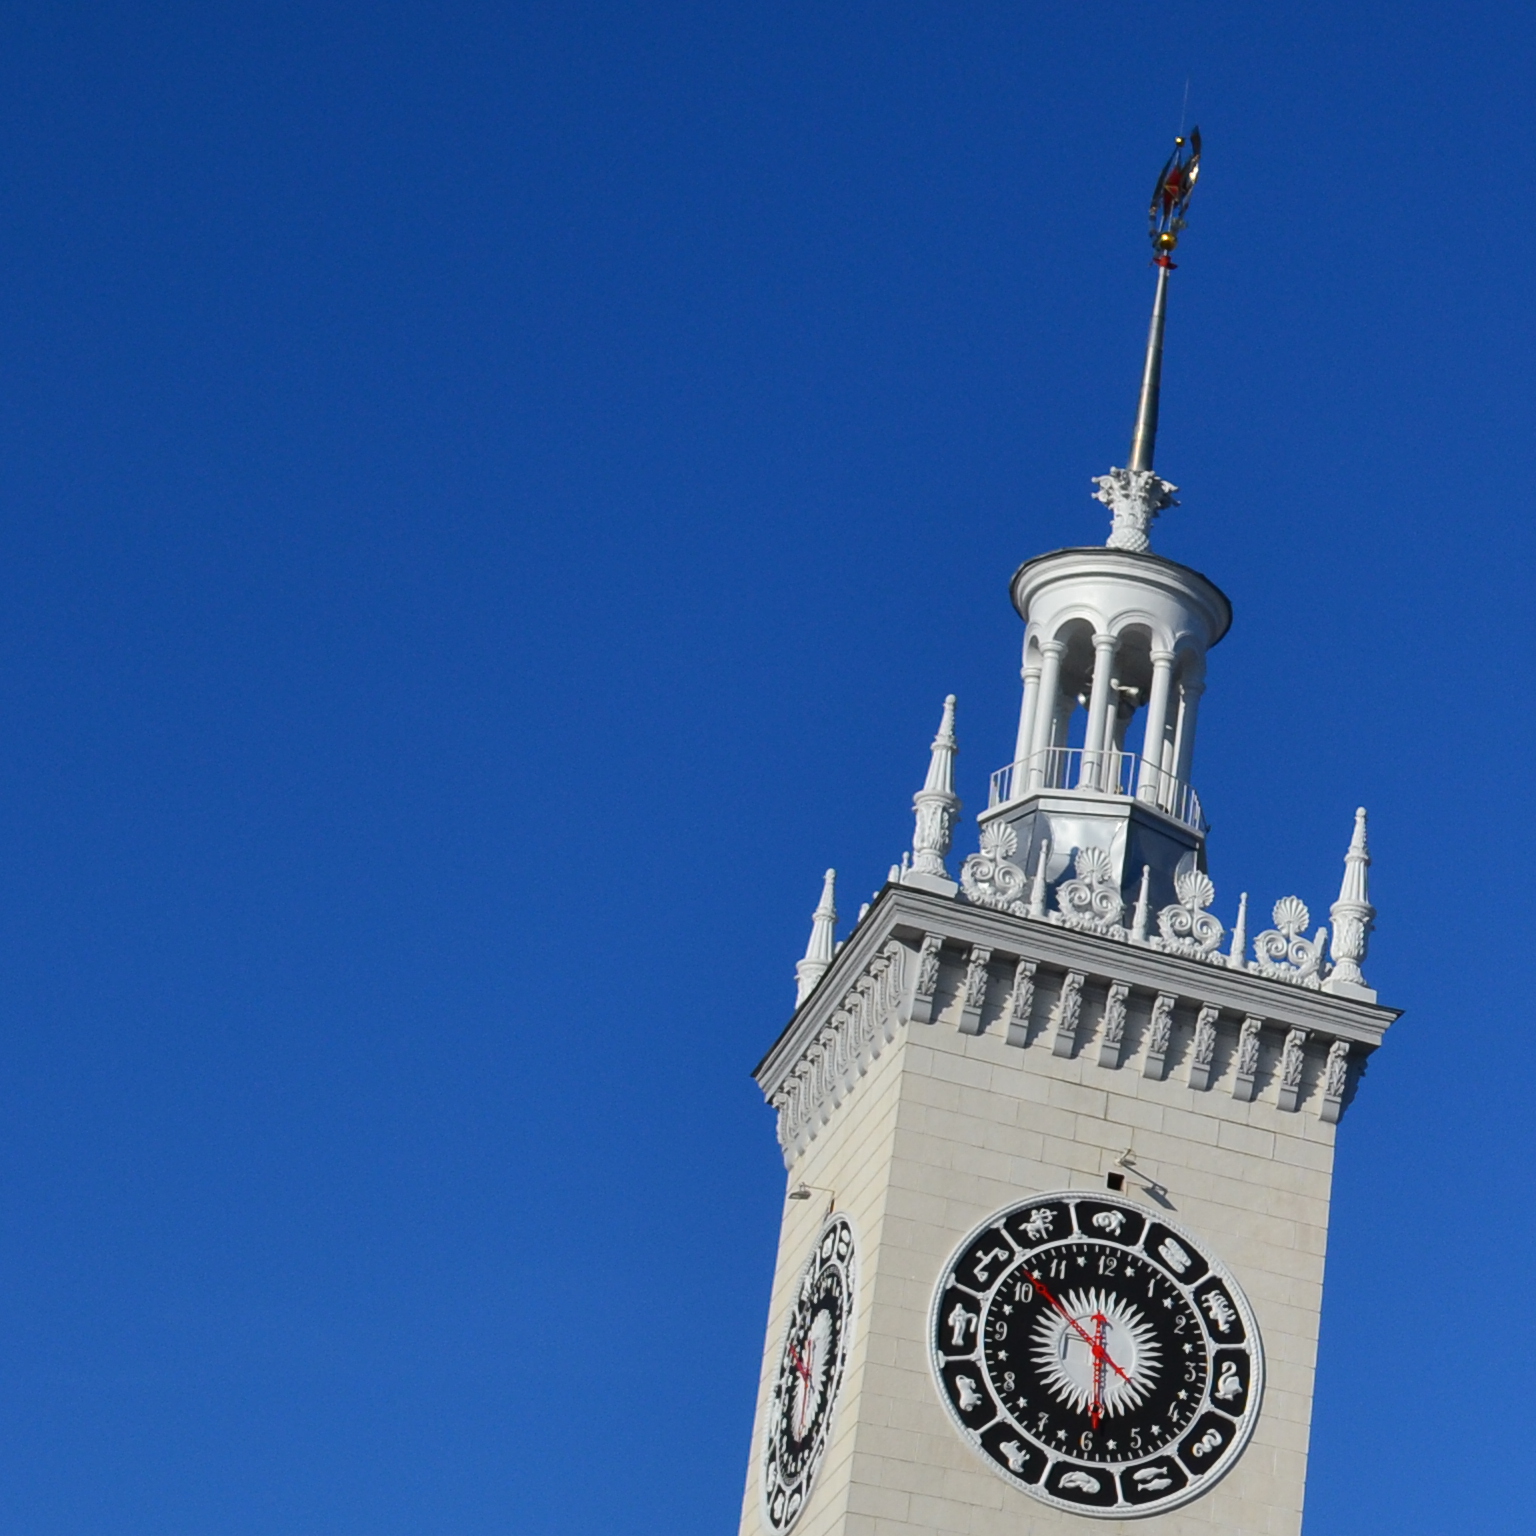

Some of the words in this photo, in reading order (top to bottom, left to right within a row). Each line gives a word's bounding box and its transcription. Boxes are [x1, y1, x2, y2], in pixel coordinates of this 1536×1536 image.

[1050, 1259, 1067, 1279] 11
[1098, 1256, 1117, 1276] 12
[1015, 1282, 1033, 1303] 10
[1147, 1279, 1155, 1297] 1
[995, 1322, 1008, 1341] 9
[1174, 1315, 1186, 1334] 2
[1004, 1372, 1015, 1391] 8
[1184, 1362, 1196, 1382] 3
[1038, 1412, 1049, 1432] 7
[1080, 1431, 1093, 1451] 6
[1131, 1428, 1141, 1448] 5
